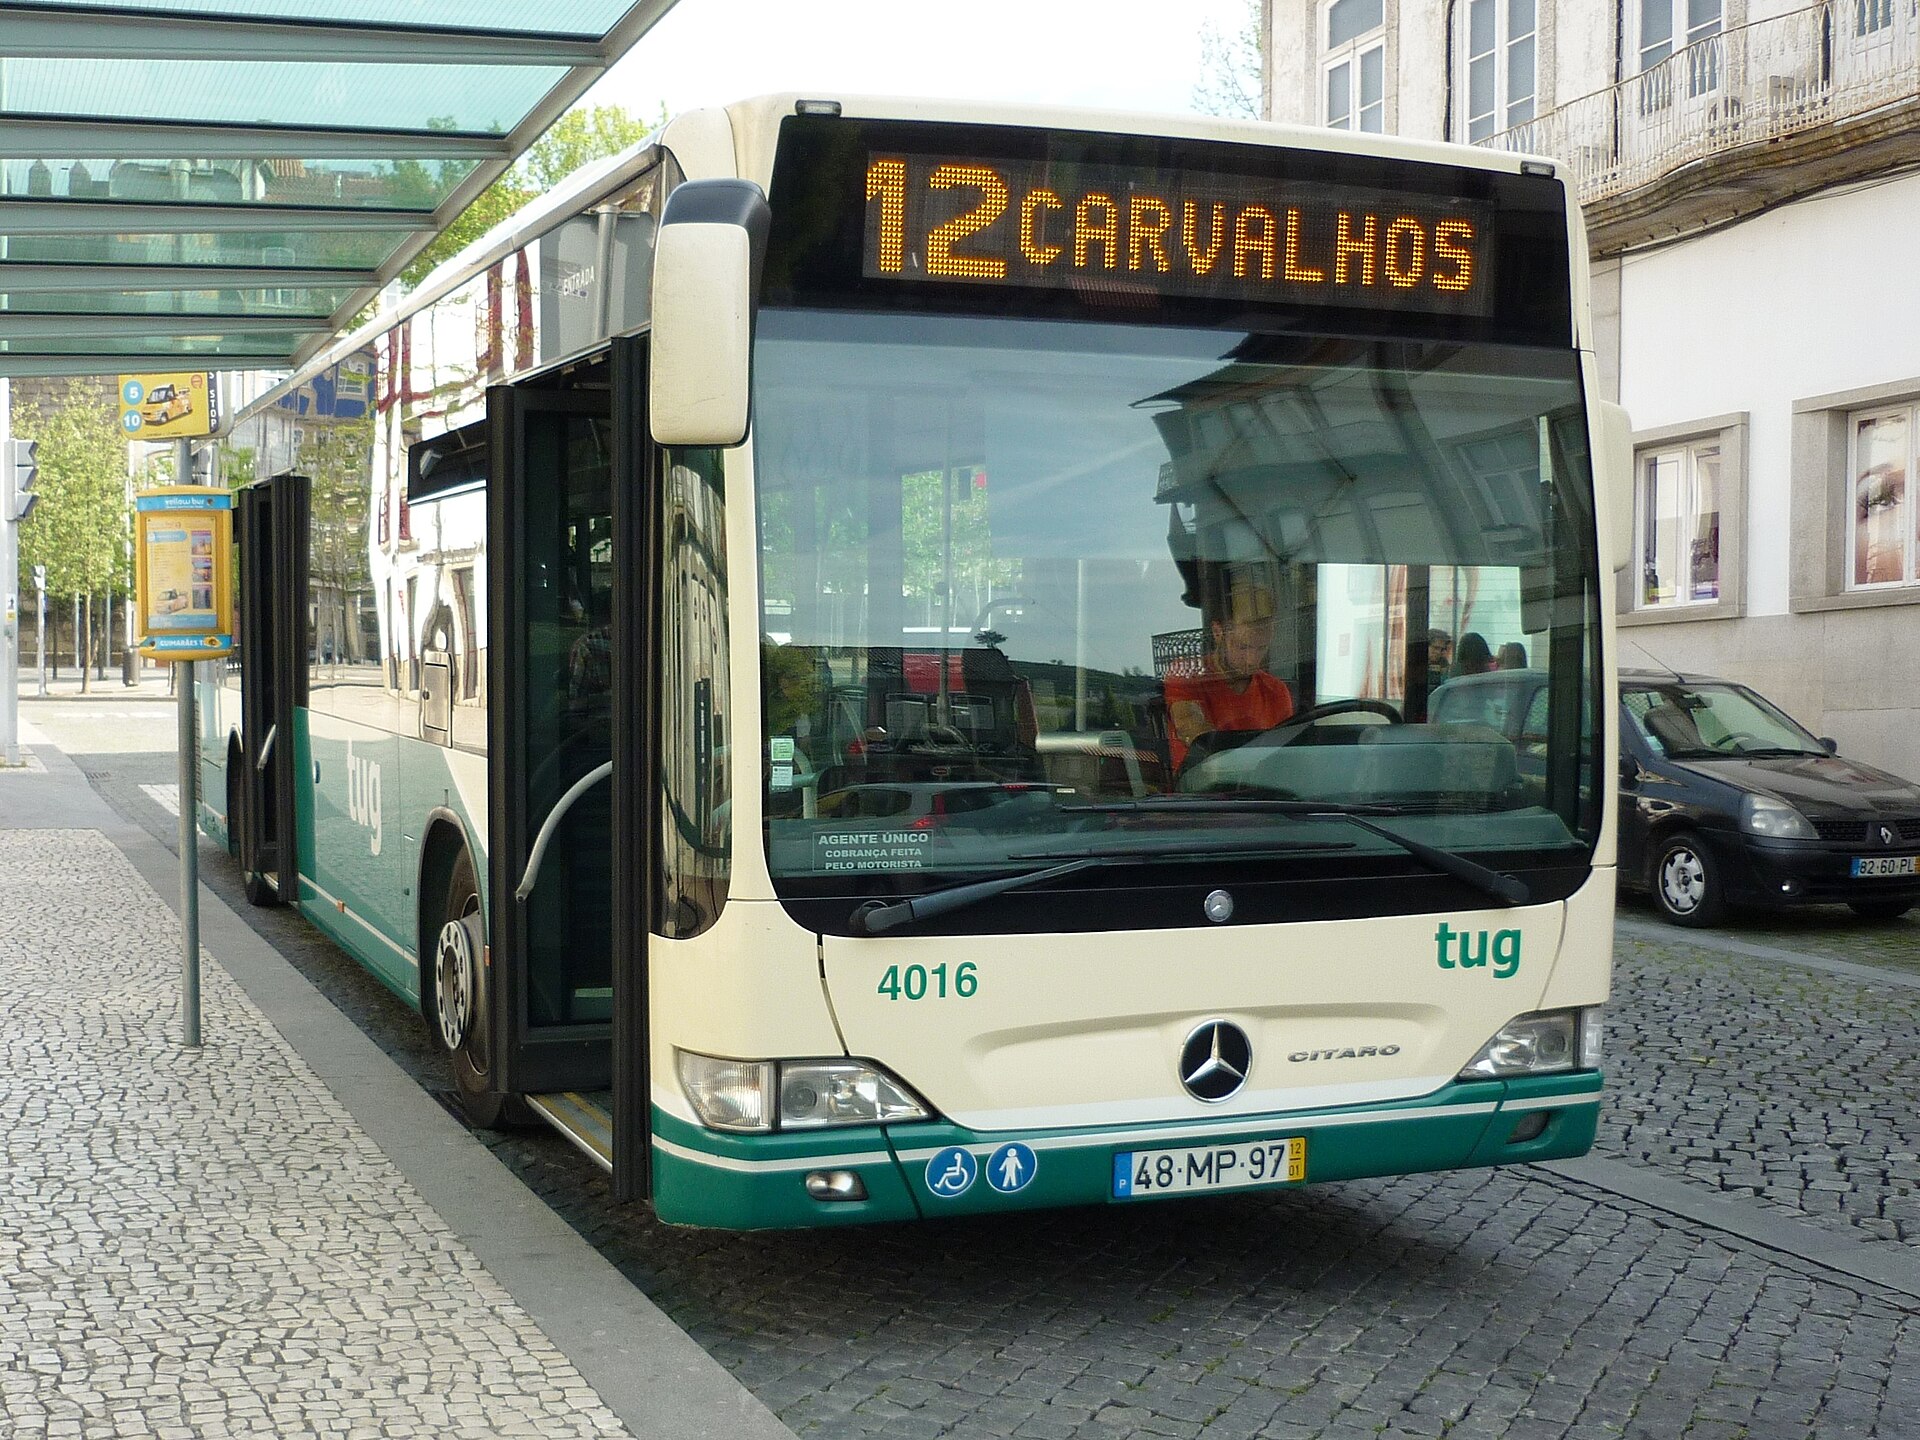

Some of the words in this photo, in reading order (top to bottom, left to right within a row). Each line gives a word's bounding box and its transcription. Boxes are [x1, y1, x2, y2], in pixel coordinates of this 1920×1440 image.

[866, 161, 1007, 279] 12
[1019, 189, 1475, 292] CARVALHOS
[129, 386, 139, 399] 5
[209, 389, 217, 428] STOP
[123, 414, 140, 428] 10
[346, 735, 382, 856] tug
[818, 834, 878, 845] AGENTE
[882, 832, 929, 843] ÚNICO
[825, 848, 888, 858] COBRANÇA
[890, 848, 922, 856] FEITA
[825, 861, 854, 870] PELO
[857, 860, 922, 869] MOTORISTA
[1434, 922, 1521, 979] tug
[877, 961, 978, 1001] 4016
[1287, 1044, 1400, 1063] CITARO
[1119, 1179, 1127, 1189] P
[1290, 1143, 1301, 1155] 12
[1288, 1165, 1300, 1176] 01
